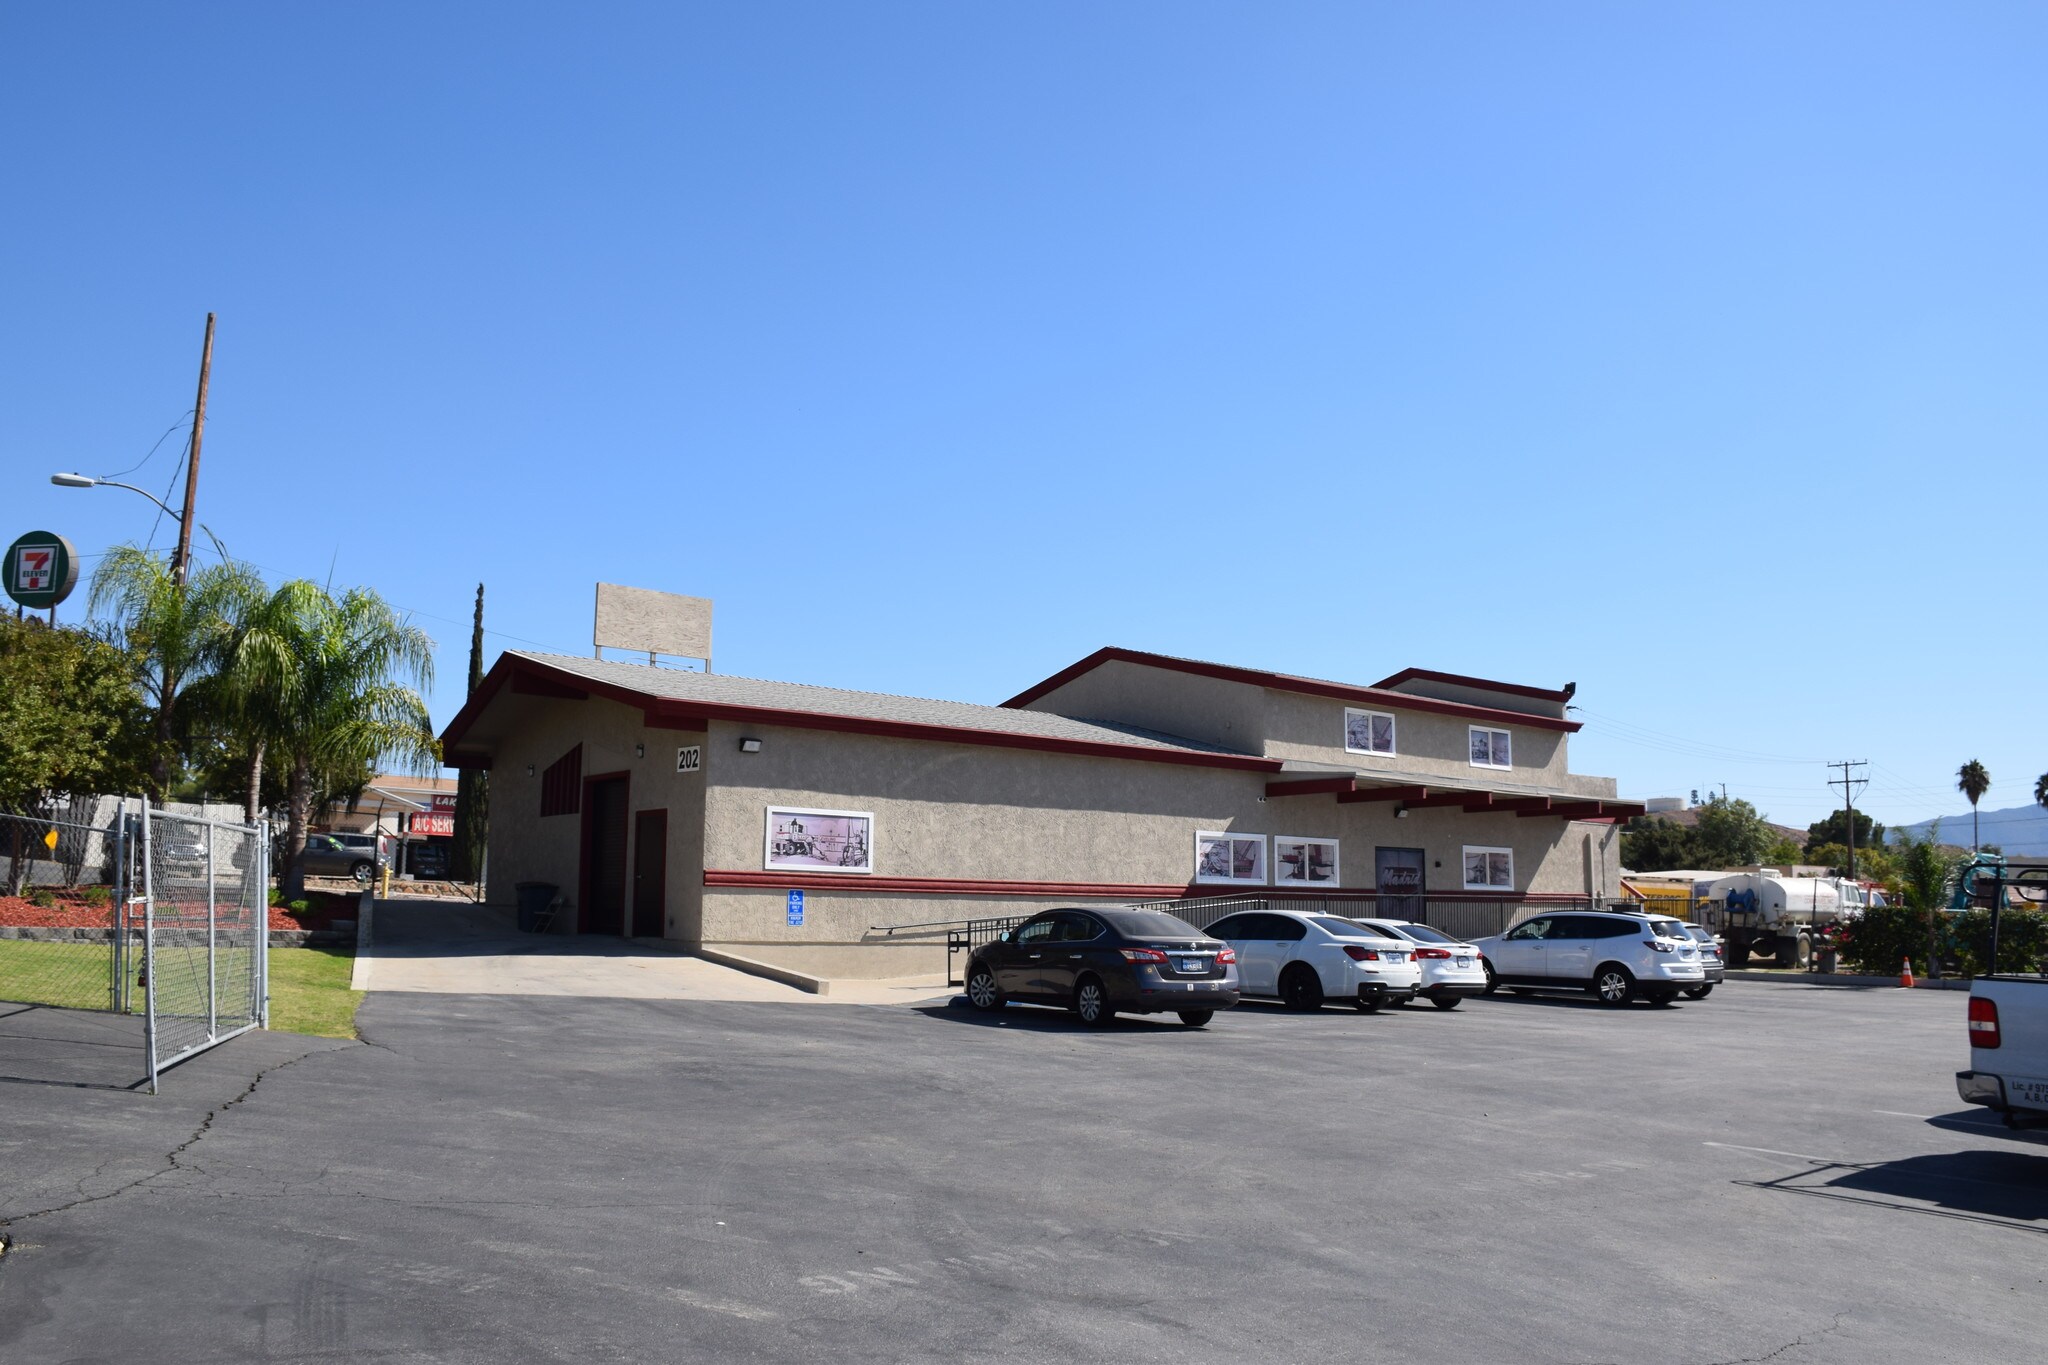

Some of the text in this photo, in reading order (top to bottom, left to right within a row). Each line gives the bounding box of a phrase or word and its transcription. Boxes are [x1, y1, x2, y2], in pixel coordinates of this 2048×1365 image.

[24, 552, 50, 589] 7
[679, 749, 699, 770] 202
[414, 814, 430, 832] A/C
[1381, 868, 1421, 886] Madrid
